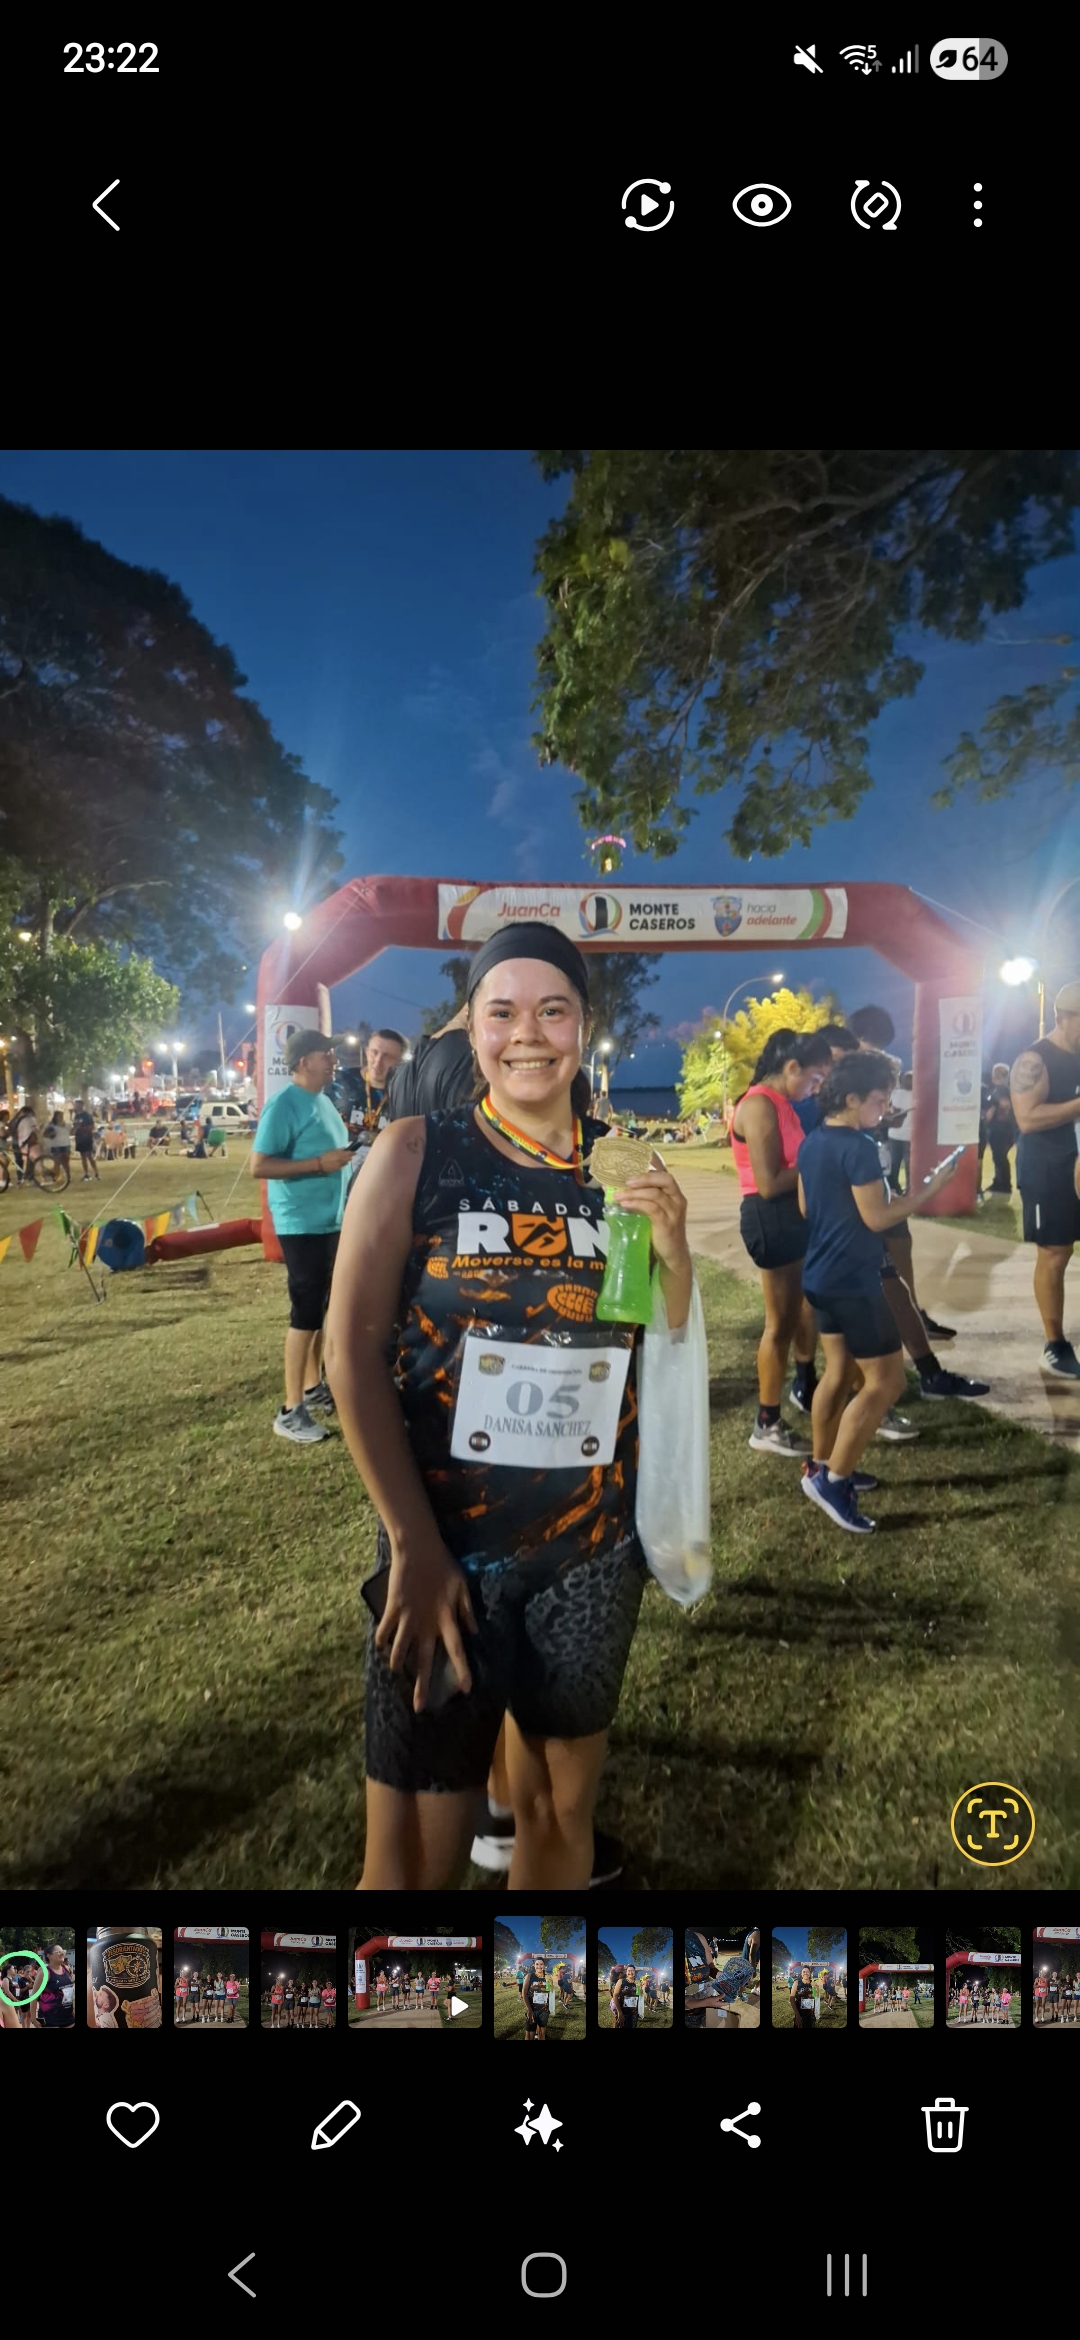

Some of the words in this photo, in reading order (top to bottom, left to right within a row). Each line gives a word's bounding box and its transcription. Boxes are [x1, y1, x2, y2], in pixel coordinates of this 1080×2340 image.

[497, 902, 561, 917] JuanCa
[629, 903, 679, 916] MONTE
[747, 903, 777, 913] hacia
[629, 917, 696, 930] CASEROS
[746, 914, 797, 926] adelante
[451, 1255, 534, 1269] Moverse
[540, 1257, 562, 1268] es
[567, 1256, 584, 1269] la
[506, 1380, 582, 1420] 05
[484, 1414, 533, 1436] DANISA
[535, 1420, 591, 1438] SANCHEZ
